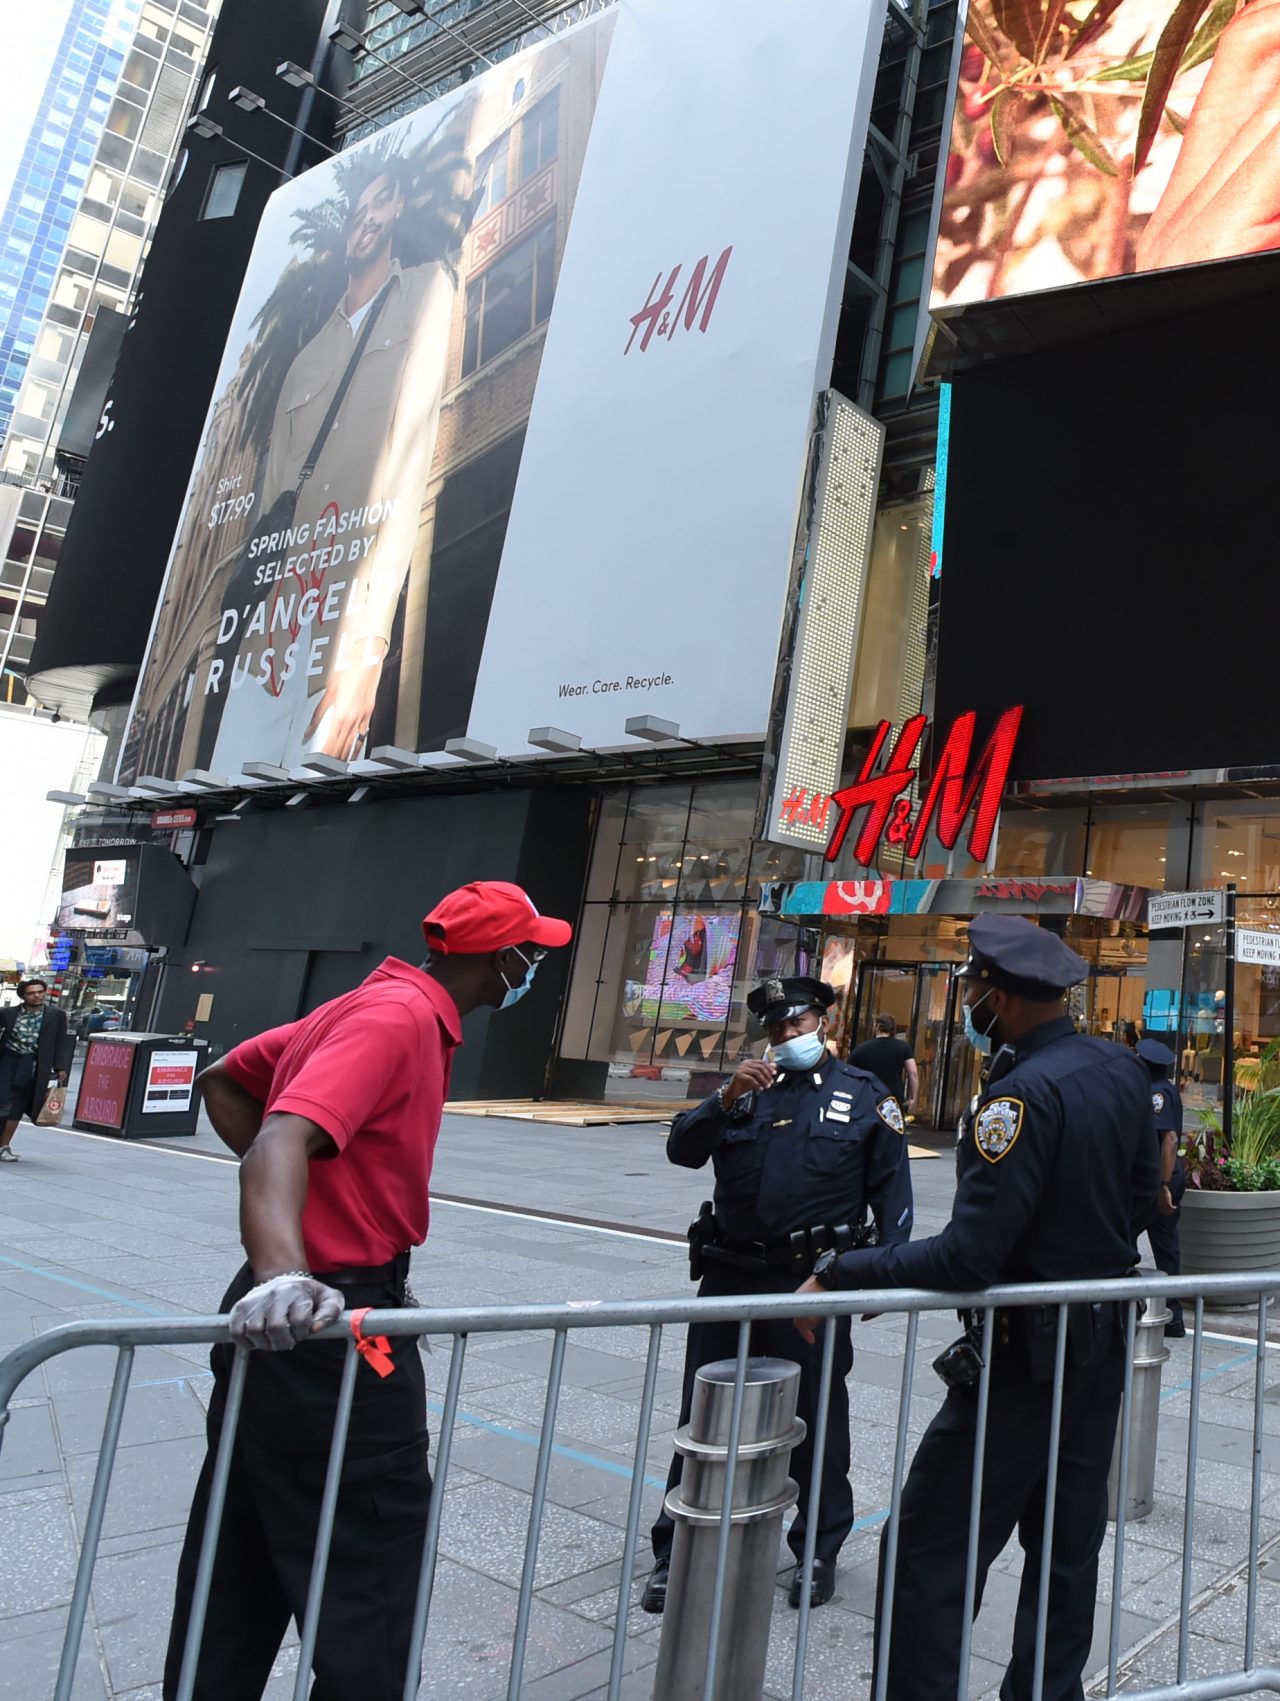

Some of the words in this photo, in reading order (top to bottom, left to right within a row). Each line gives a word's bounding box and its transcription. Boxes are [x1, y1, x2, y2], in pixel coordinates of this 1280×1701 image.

[624, 245, 733, 356] H&M
[216, 474, 243, 495] Shirt
[207, 491, 256, 530] $17.99
[248, 523, 310, 559] SPRING
[313, 497, 399, 540] FASHION
[254, 543, 344, 586] SELECTED
[348, 534, 376, 562] BY
[216, 577, 370, 646] D'ANGEL
[558, 684, 589, 698] Wear.
[592, 679, 623, 694] Care.
[625, 672, 675, 691] Recycle.
[825, 703, 1024, 867] H&M
[779, 785, 831, 832] H&M
[1151, 899, 1179, 912] PEDESTRIAN
[1180, 897, 1196, 908] FLOW
[1198, 895, 1216, 906] ZONE
[1151, 914, 1163, 925] KEEP
[1164, 912, 1182, 923] MOVING
[1242, 934, 1274, 949] PEDESTRIAN
[1242, 948, 1256, 958] KEEP
[1257, 950, 1276, 961] MOVING
[90, 1044, 131, 1069] EMBRACE
[98, 1073, 110, 1090] THE
[82, 1097, 118, 1123] ABSURD
